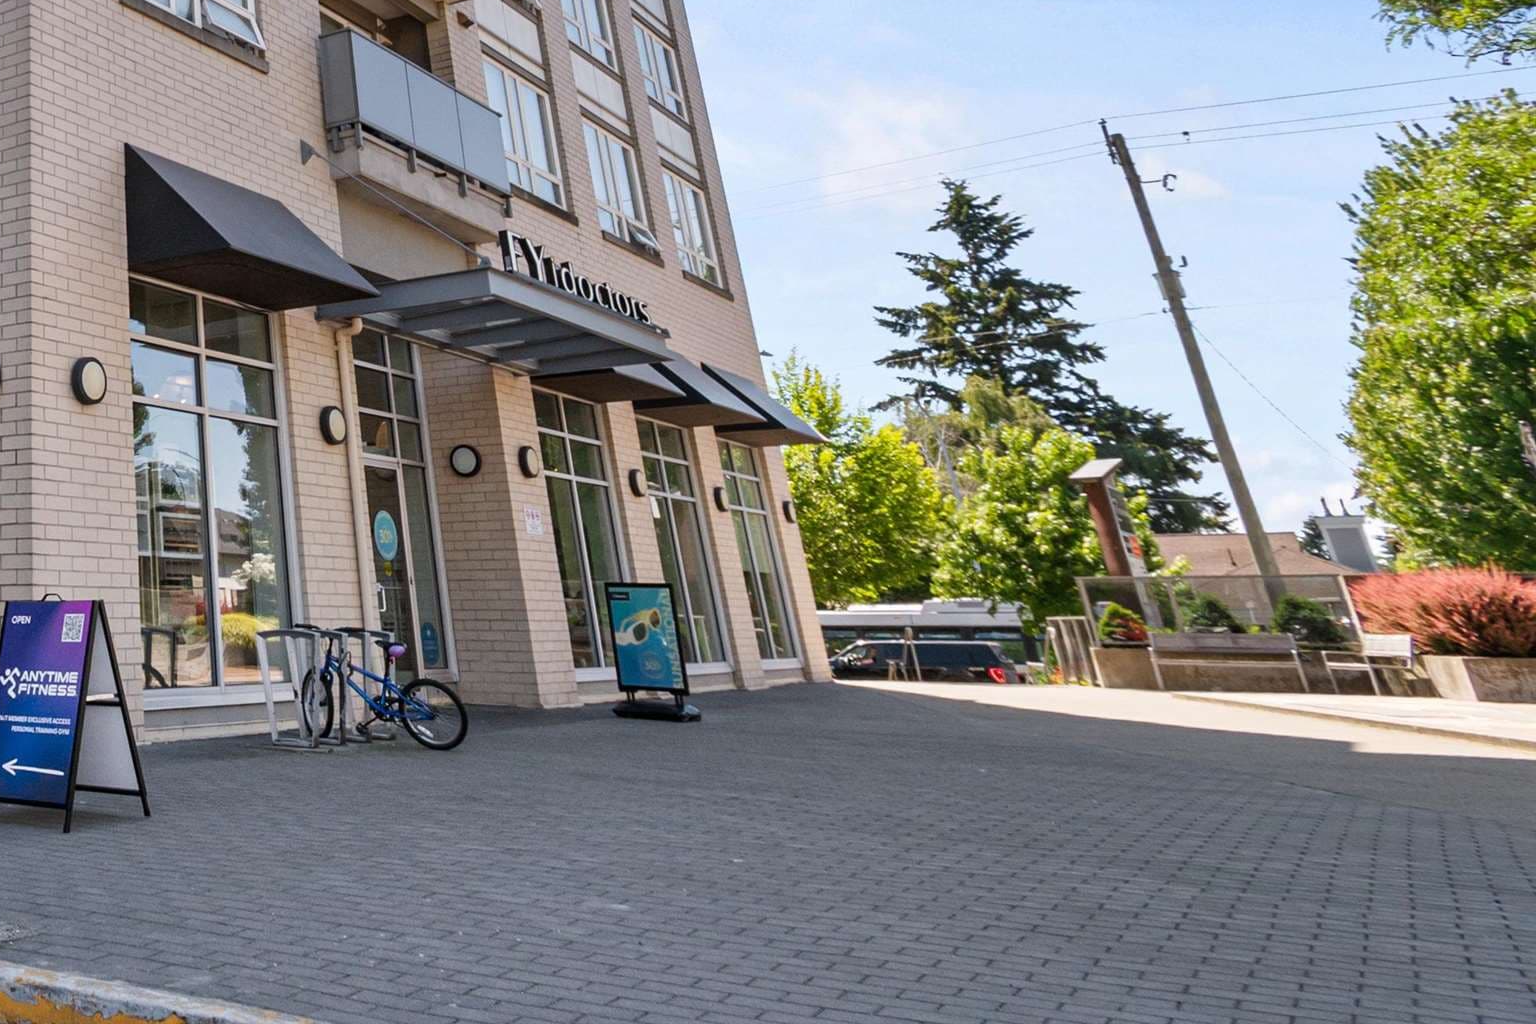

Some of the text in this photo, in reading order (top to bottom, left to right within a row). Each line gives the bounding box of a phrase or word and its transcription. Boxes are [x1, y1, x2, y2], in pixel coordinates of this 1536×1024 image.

[499, 230, 652, 325] FYidoctors
[11, 616, 32, 624] OPEN
[20, 670, 79, 684] ANYTIME
[17, 683, 77, 696] FITNESS
